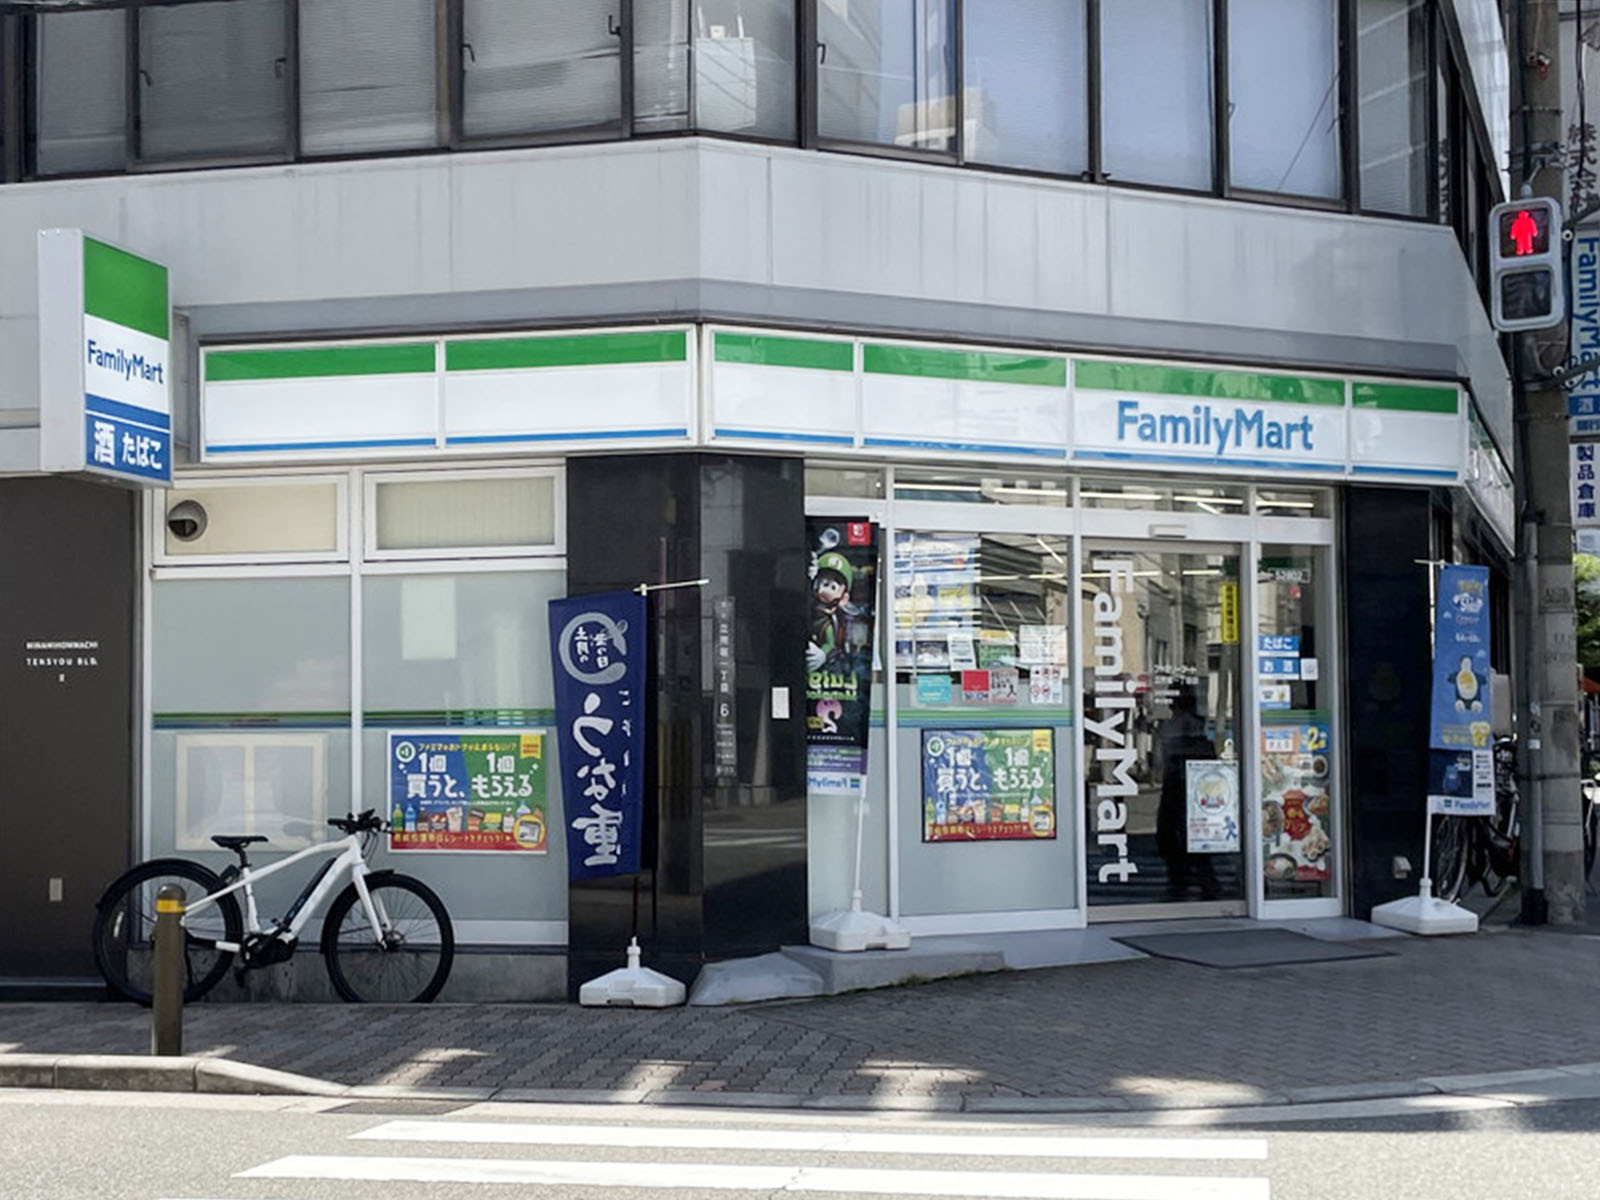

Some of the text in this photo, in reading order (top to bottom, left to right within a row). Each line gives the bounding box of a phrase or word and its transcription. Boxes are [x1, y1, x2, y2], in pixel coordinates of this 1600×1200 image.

[87, 340, 163, 384] FamilyMart
[1117, 400, 1314, 456] FamilyMart
[121, 432, 162, 470] たばこ
[1263, 636, 1293, 649] たばこ
[719, 703, 730, 717] 6
[1082, 559, 1139, 883] FamilyMart
[419, 753, 447, 773] 1個
[487, 753, 515, 773] 1個
[946, 748, 971, 767] 1個
[1005, 748, 1029, 767] 1個
[407, 774, 465, 798] 買うと、
[472, 774, 533, 798] もらえる
[938, 768, 987, 792] 買うと、
[993, 768, 1044, 791] もらえる
